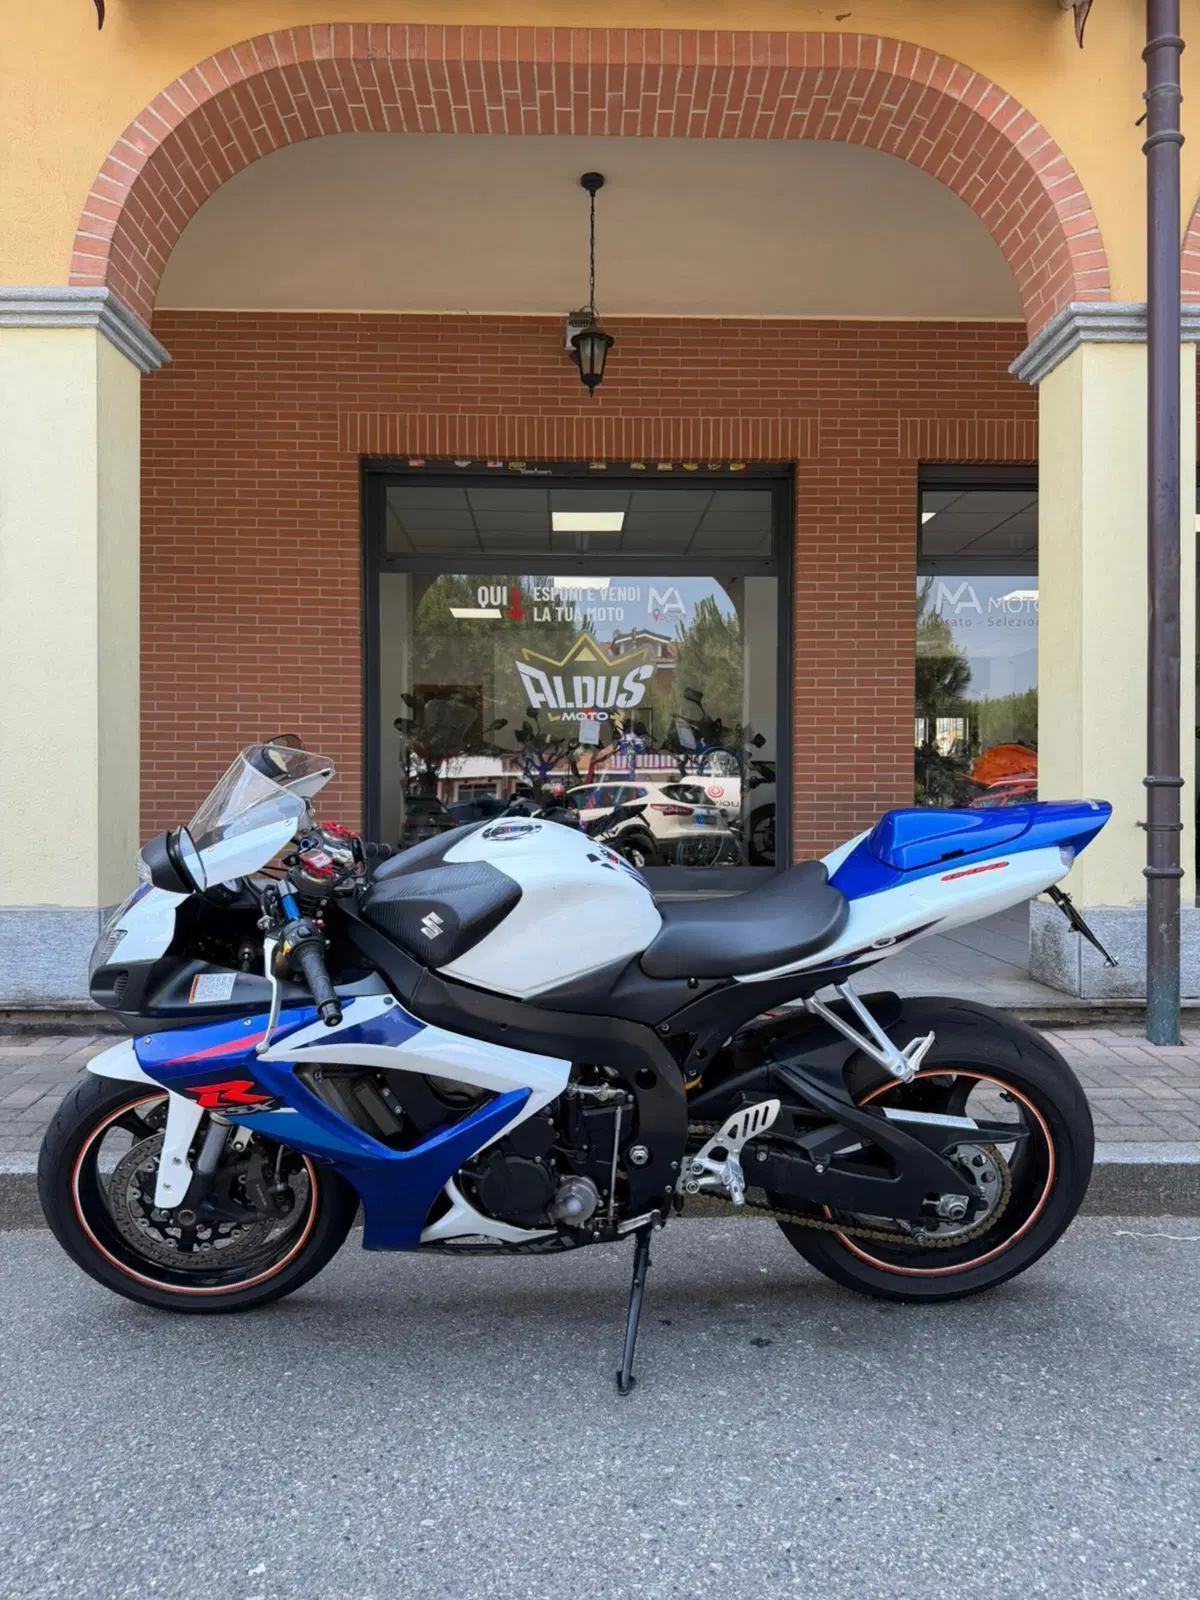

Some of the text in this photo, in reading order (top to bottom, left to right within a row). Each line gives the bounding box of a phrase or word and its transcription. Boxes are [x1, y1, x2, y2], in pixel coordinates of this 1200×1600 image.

[477, 585, 507, 608] QUI
[533, 586, 641, 602] ESPONI E VENDI
[647, 587, 686, 614] MA
[934, 581, 1039, 614] MA MOT
[533, 606, 624, 622] LA TUA MOTO
[987, 616, 1039, 627] Selezio
[515, 660, 655, 709] ALDUS
[561, 711, 609, 722] MOTO
